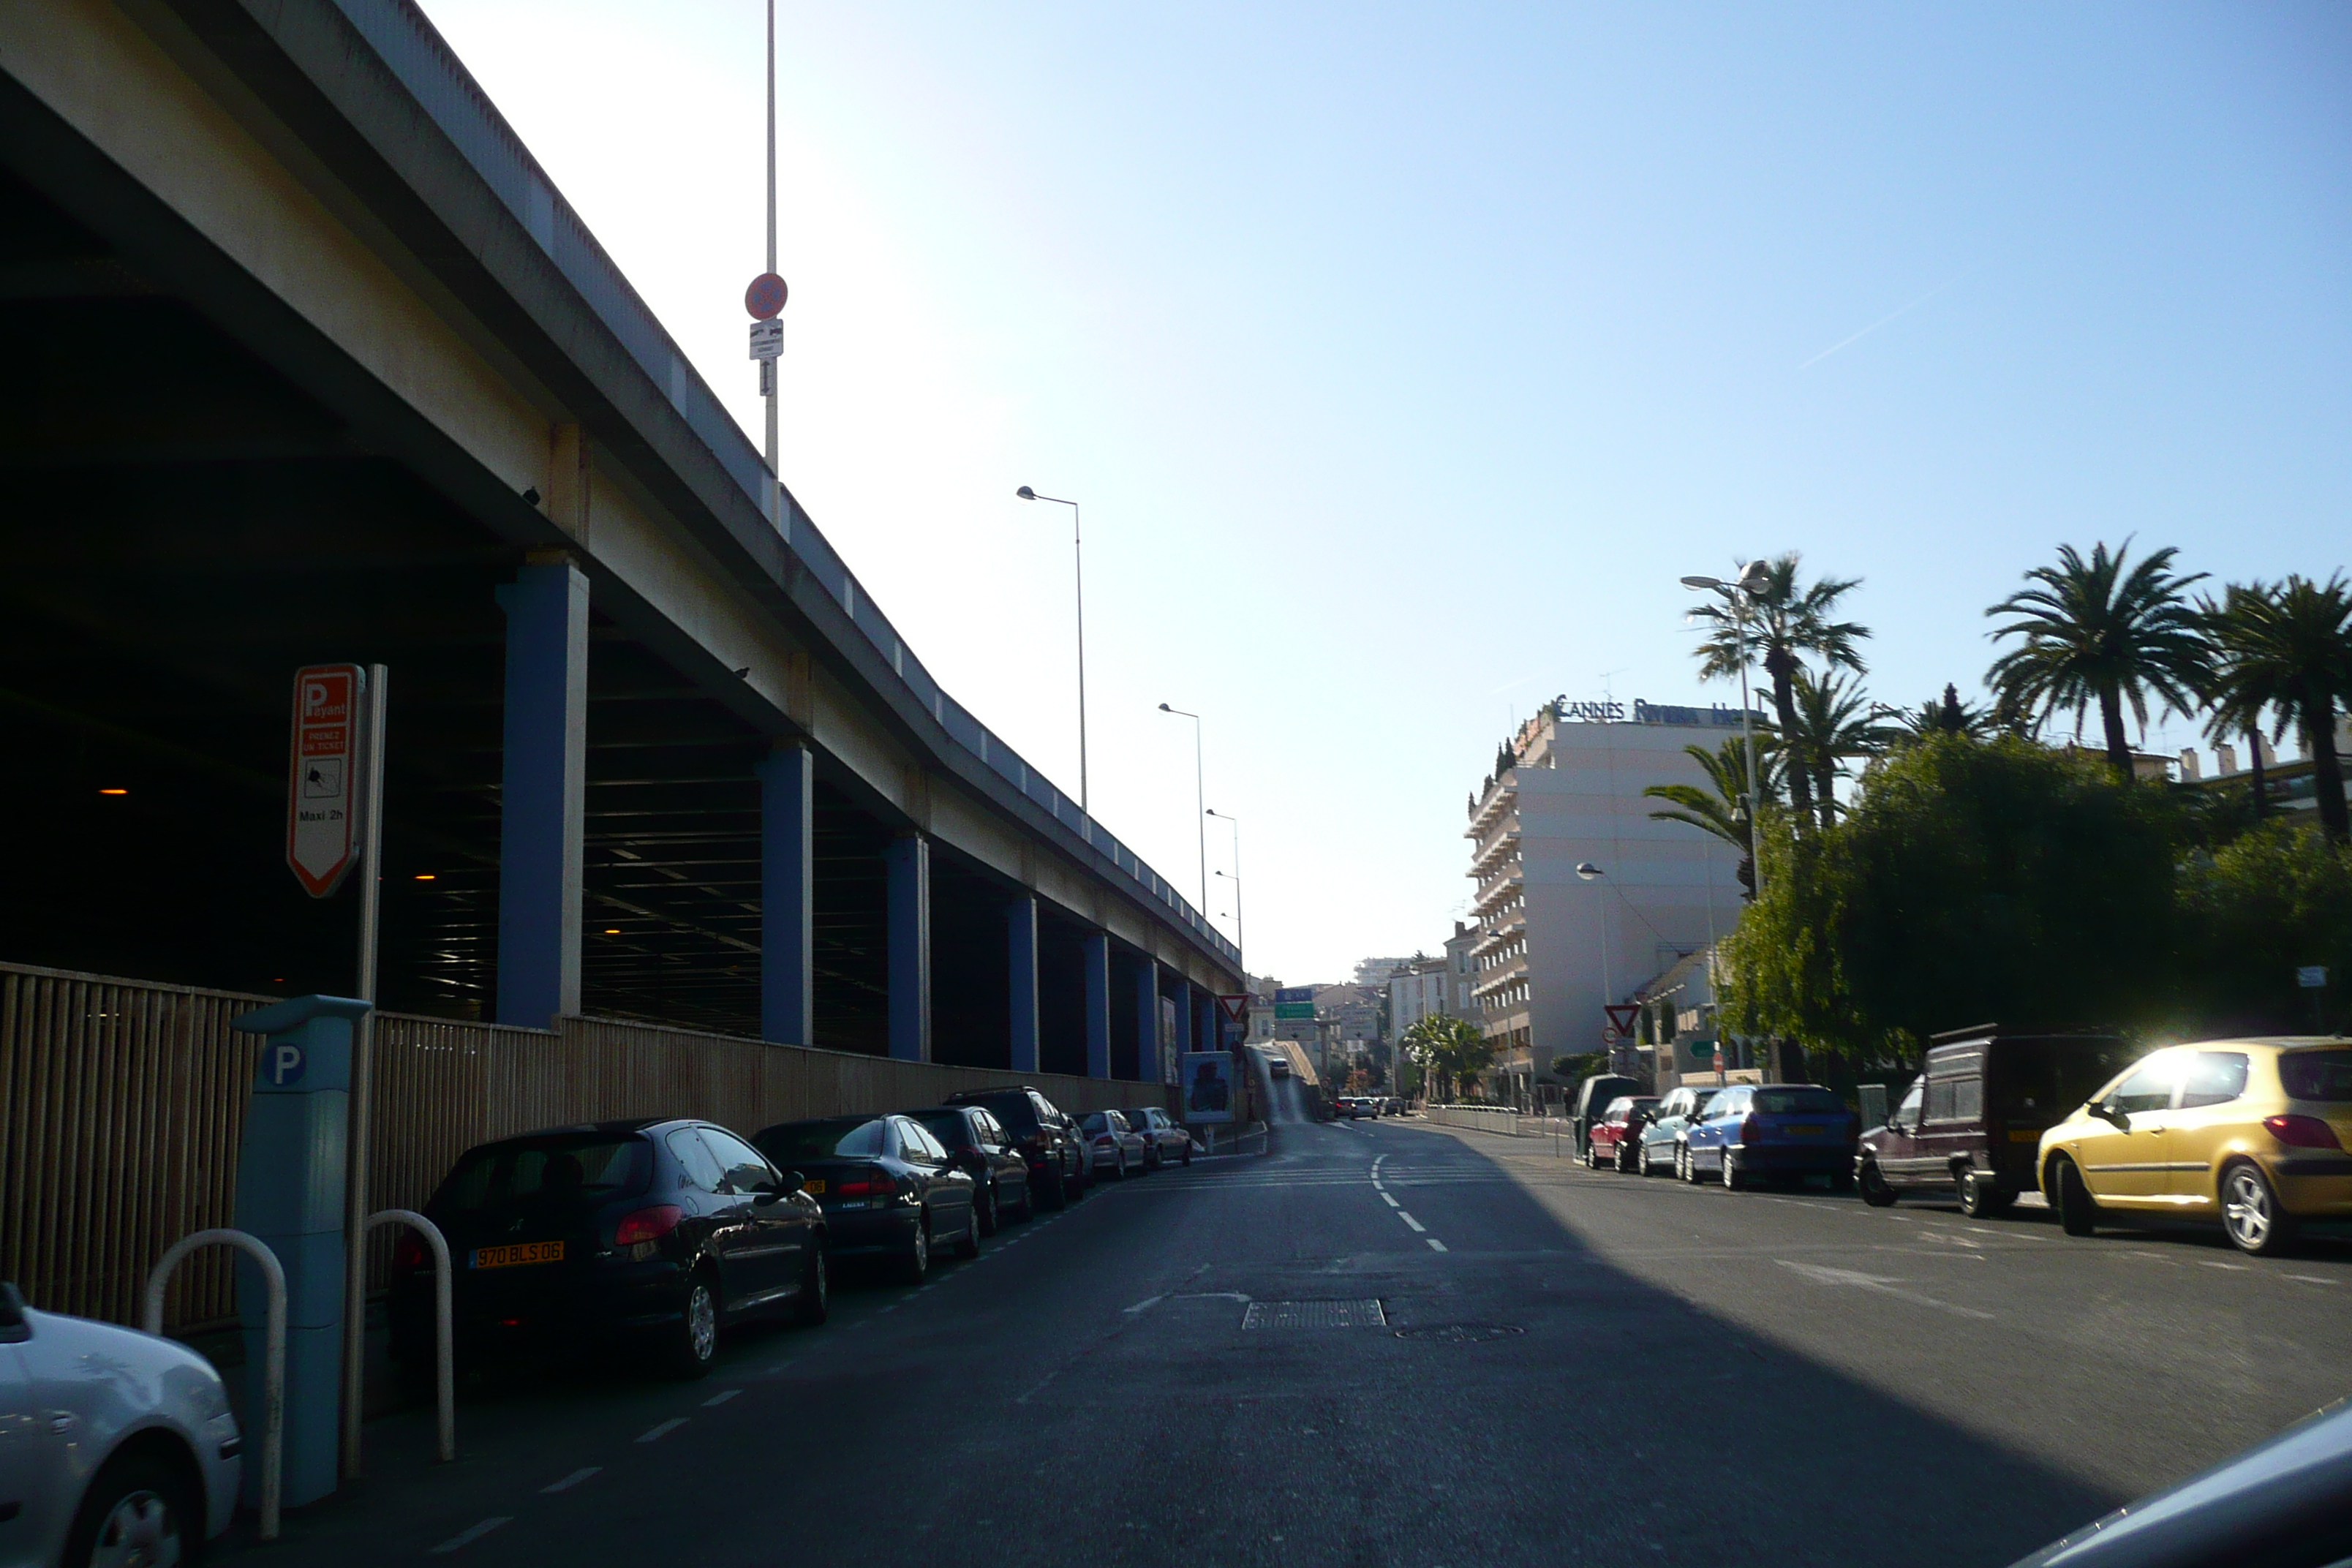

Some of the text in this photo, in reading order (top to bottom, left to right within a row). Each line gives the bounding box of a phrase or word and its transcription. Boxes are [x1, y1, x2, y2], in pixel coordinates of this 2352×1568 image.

[305, 682, 346, 719] Payant
[1555, 693, 1625, 719] CANNES
[304, 741, 344, 752] UN TICKET
[299, 809, 343, 822] Maxi 2h
[274, 1045, 301, 1085] P
[478, 1243, 561, 1266] 970 BLS 06
